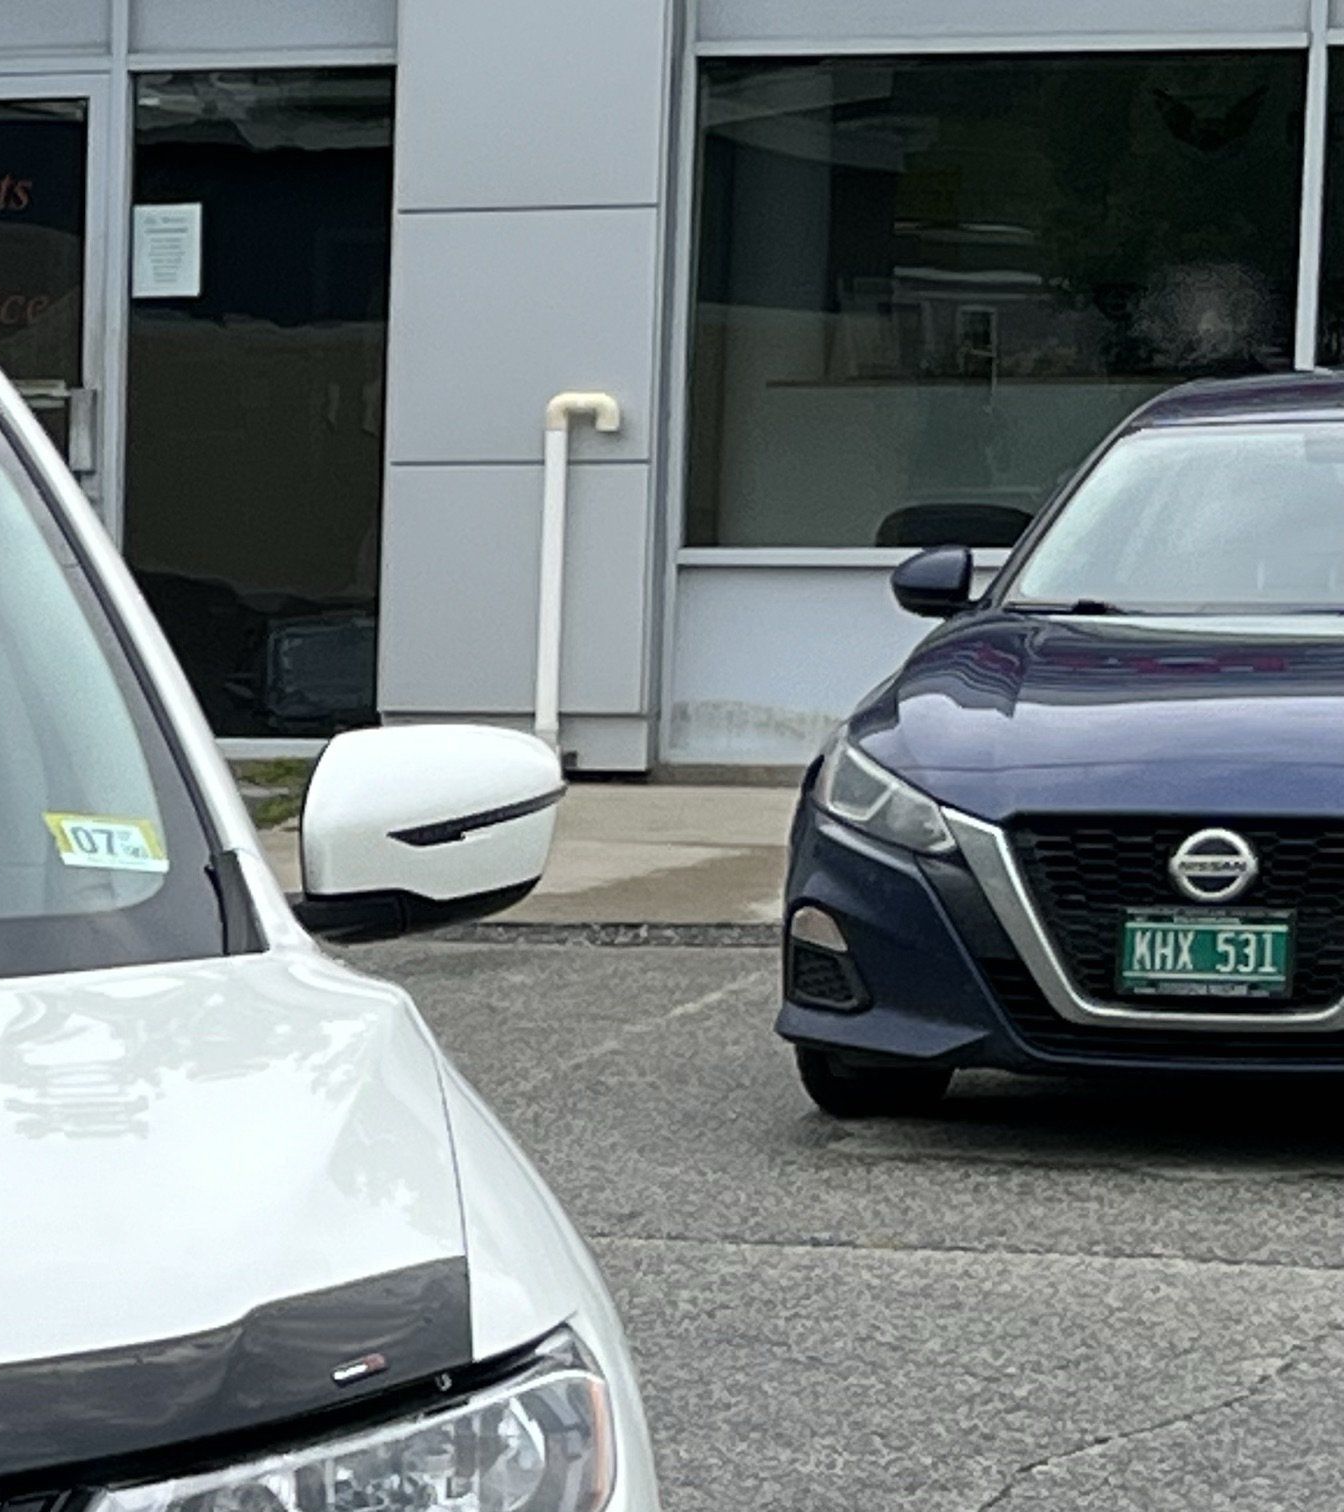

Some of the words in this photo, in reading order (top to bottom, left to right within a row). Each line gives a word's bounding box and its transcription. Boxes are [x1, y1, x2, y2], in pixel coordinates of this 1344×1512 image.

[70, 826, 116, 855] 07
[1132, 930, 1195, 971] KHX
[1216, 932, 1278, 973] 531
